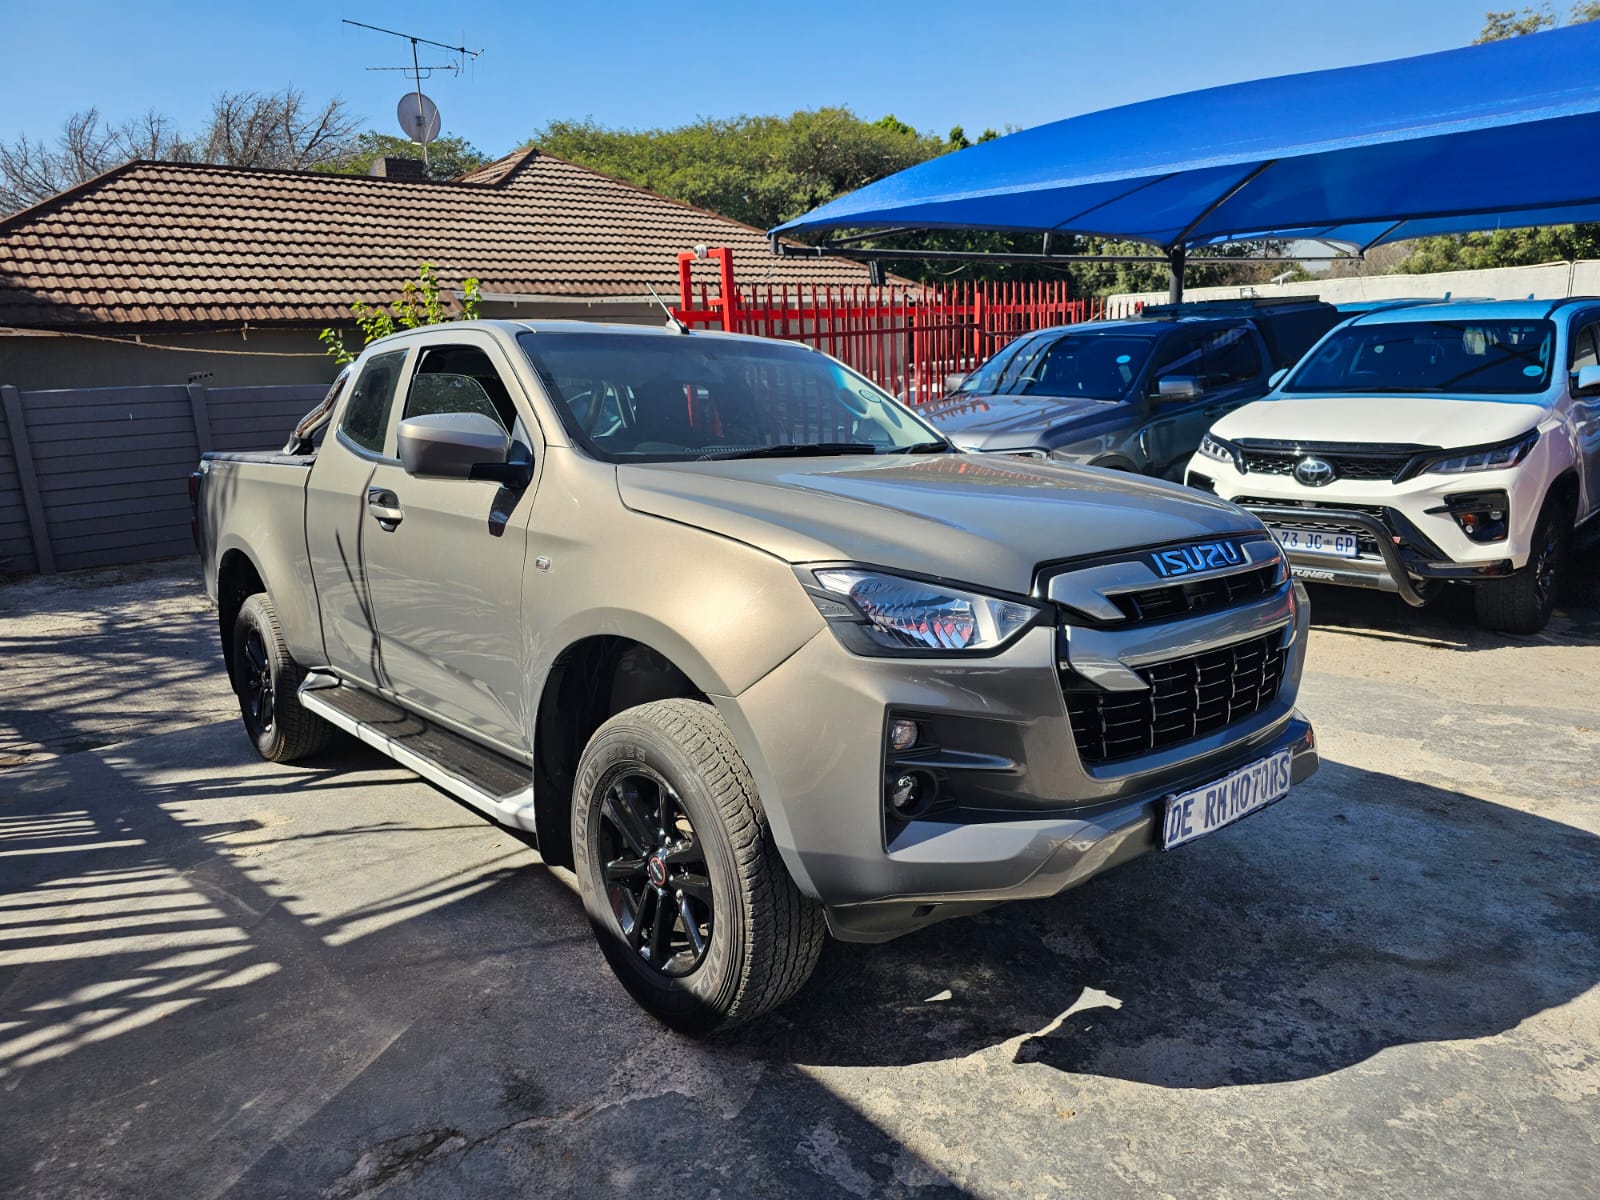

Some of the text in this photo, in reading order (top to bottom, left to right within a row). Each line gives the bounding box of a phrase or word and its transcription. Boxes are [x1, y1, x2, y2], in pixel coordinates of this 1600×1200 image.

[1151, 541, 1241, 577] ISUZU
[1305, 533, 1322, 550] JC
[1335, 536, 1353, 553] GP
[1291, 568, 1335, 581] TUNER
[575, 758, 600, 864] DUNLOP
[1168, 797, 1195, 843] DE
